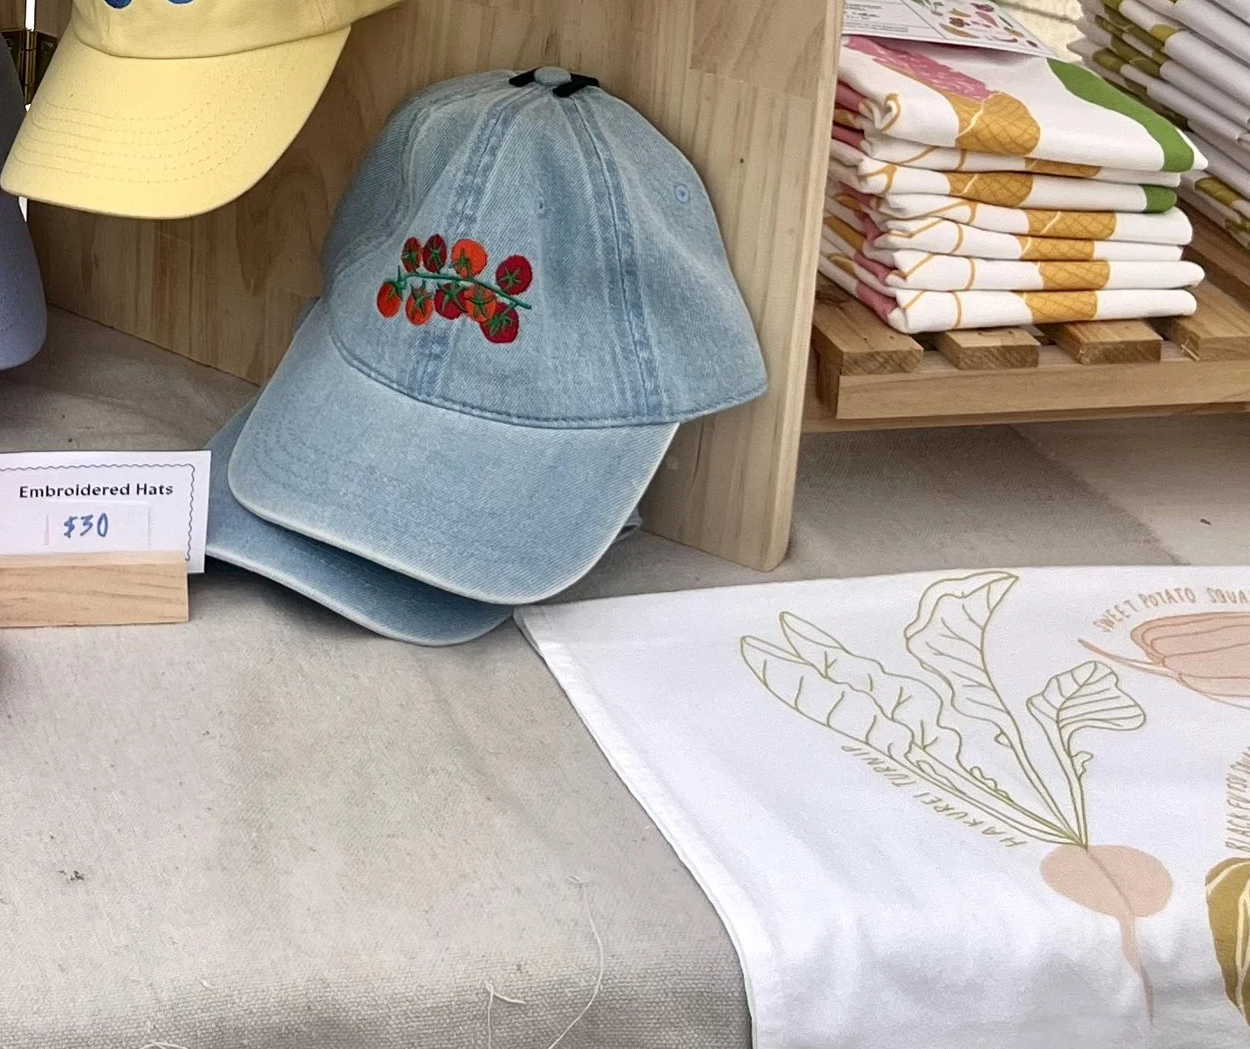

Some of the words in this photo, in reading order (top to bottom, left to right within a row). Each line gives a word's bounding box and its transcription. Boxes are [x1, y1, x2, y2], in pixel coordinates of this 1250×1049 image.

[19, 483, 130, 499] Embroidered
[136, 483, 173, 496] Hats
[63, 512, 109, 539] $30
[1138, 587, 1196, 609] POTATO
[841, 745, 917, 787] TURNIP
[913, 792, 1027, 848] HAKUREI
